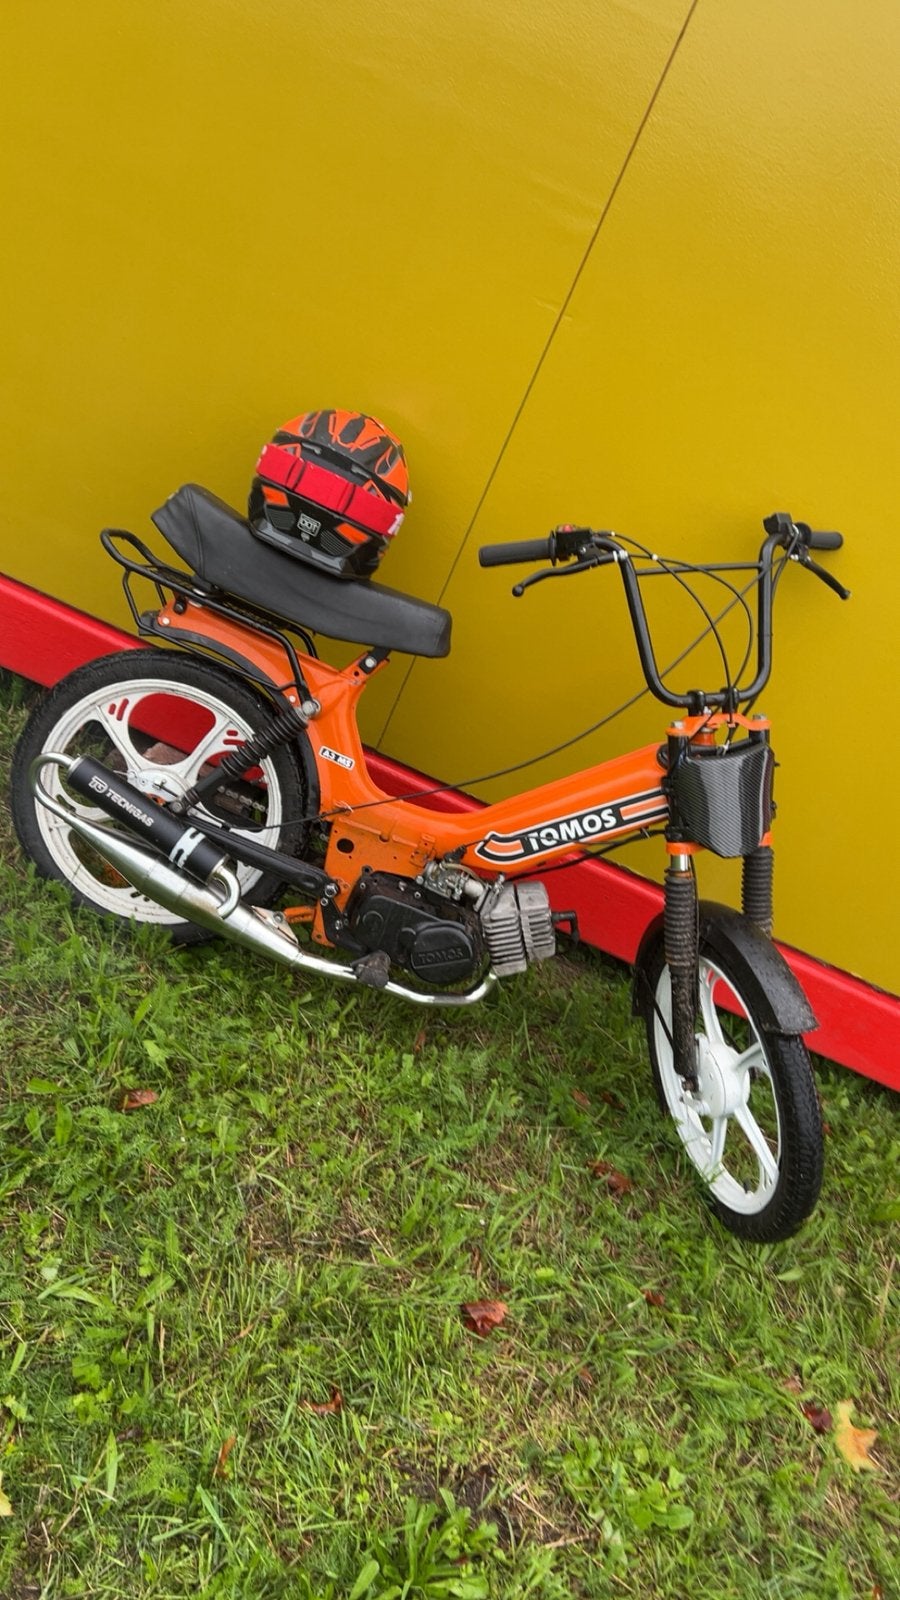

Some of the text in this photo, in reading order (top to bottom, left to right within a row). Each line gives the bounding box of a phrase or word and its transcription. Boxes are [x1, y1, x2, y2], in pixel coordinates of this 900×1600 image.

[105, 788, 155, 827] TECNIGAS
[527, 808, 617, 851] TOMOS
[417, 947, 464, 964] TOMOS
